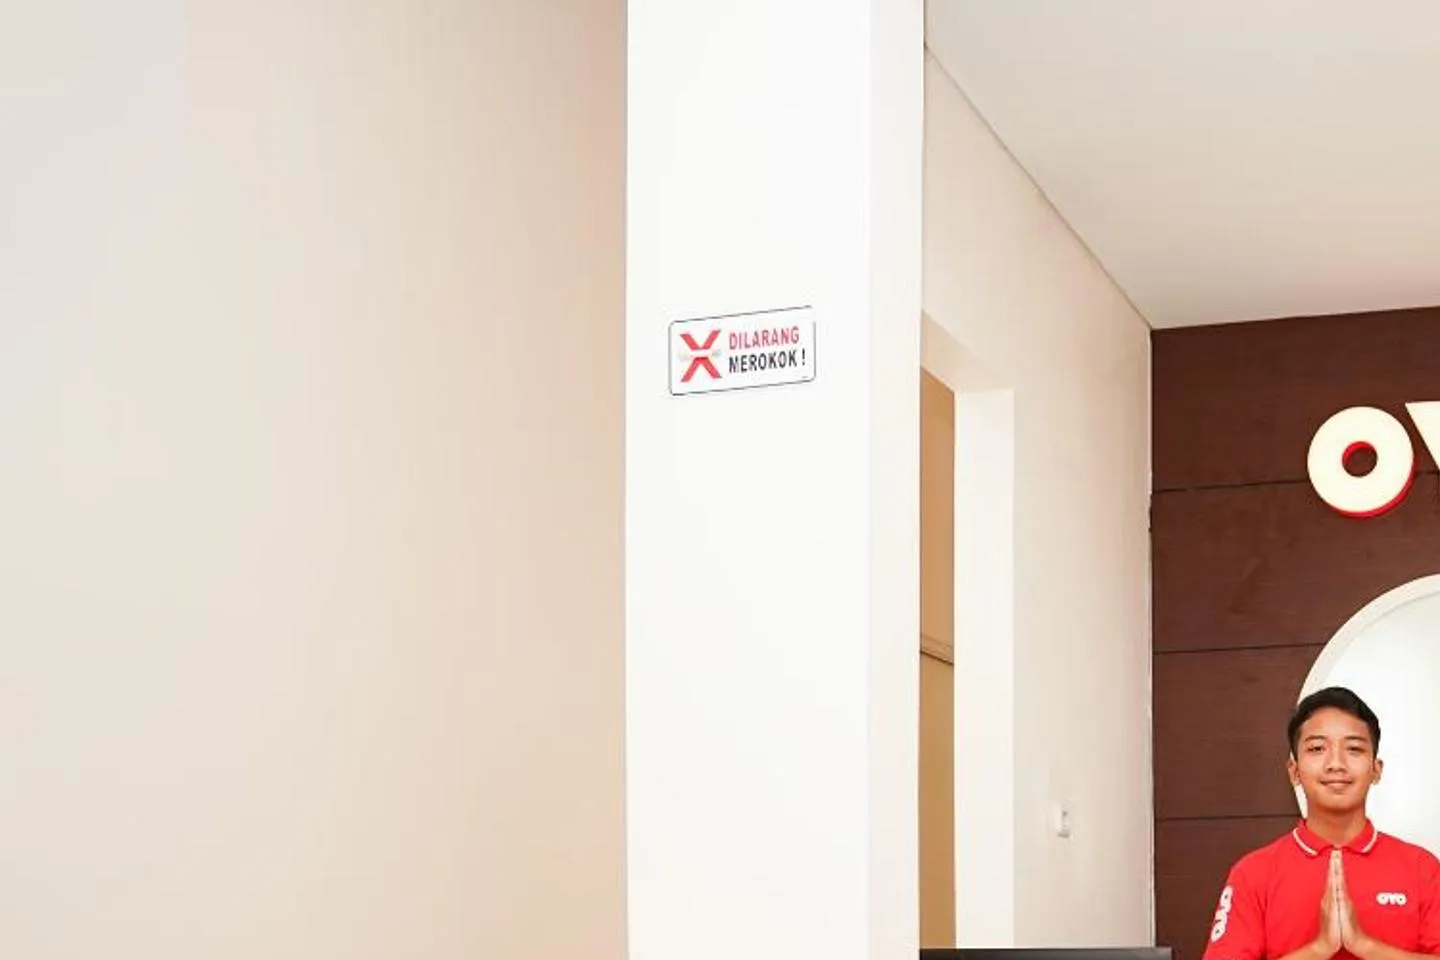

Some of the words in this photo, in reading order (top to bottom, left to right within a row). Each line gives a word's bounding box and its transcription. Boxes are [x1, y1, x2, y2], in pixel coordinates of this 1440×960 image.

[729, 326, 800, 350] DILARANG
[729, 350, 798, 374] MEROKOK
[1376, 892, 1407, 906] OYO
[1211, 885, 1234, 943] OYO
